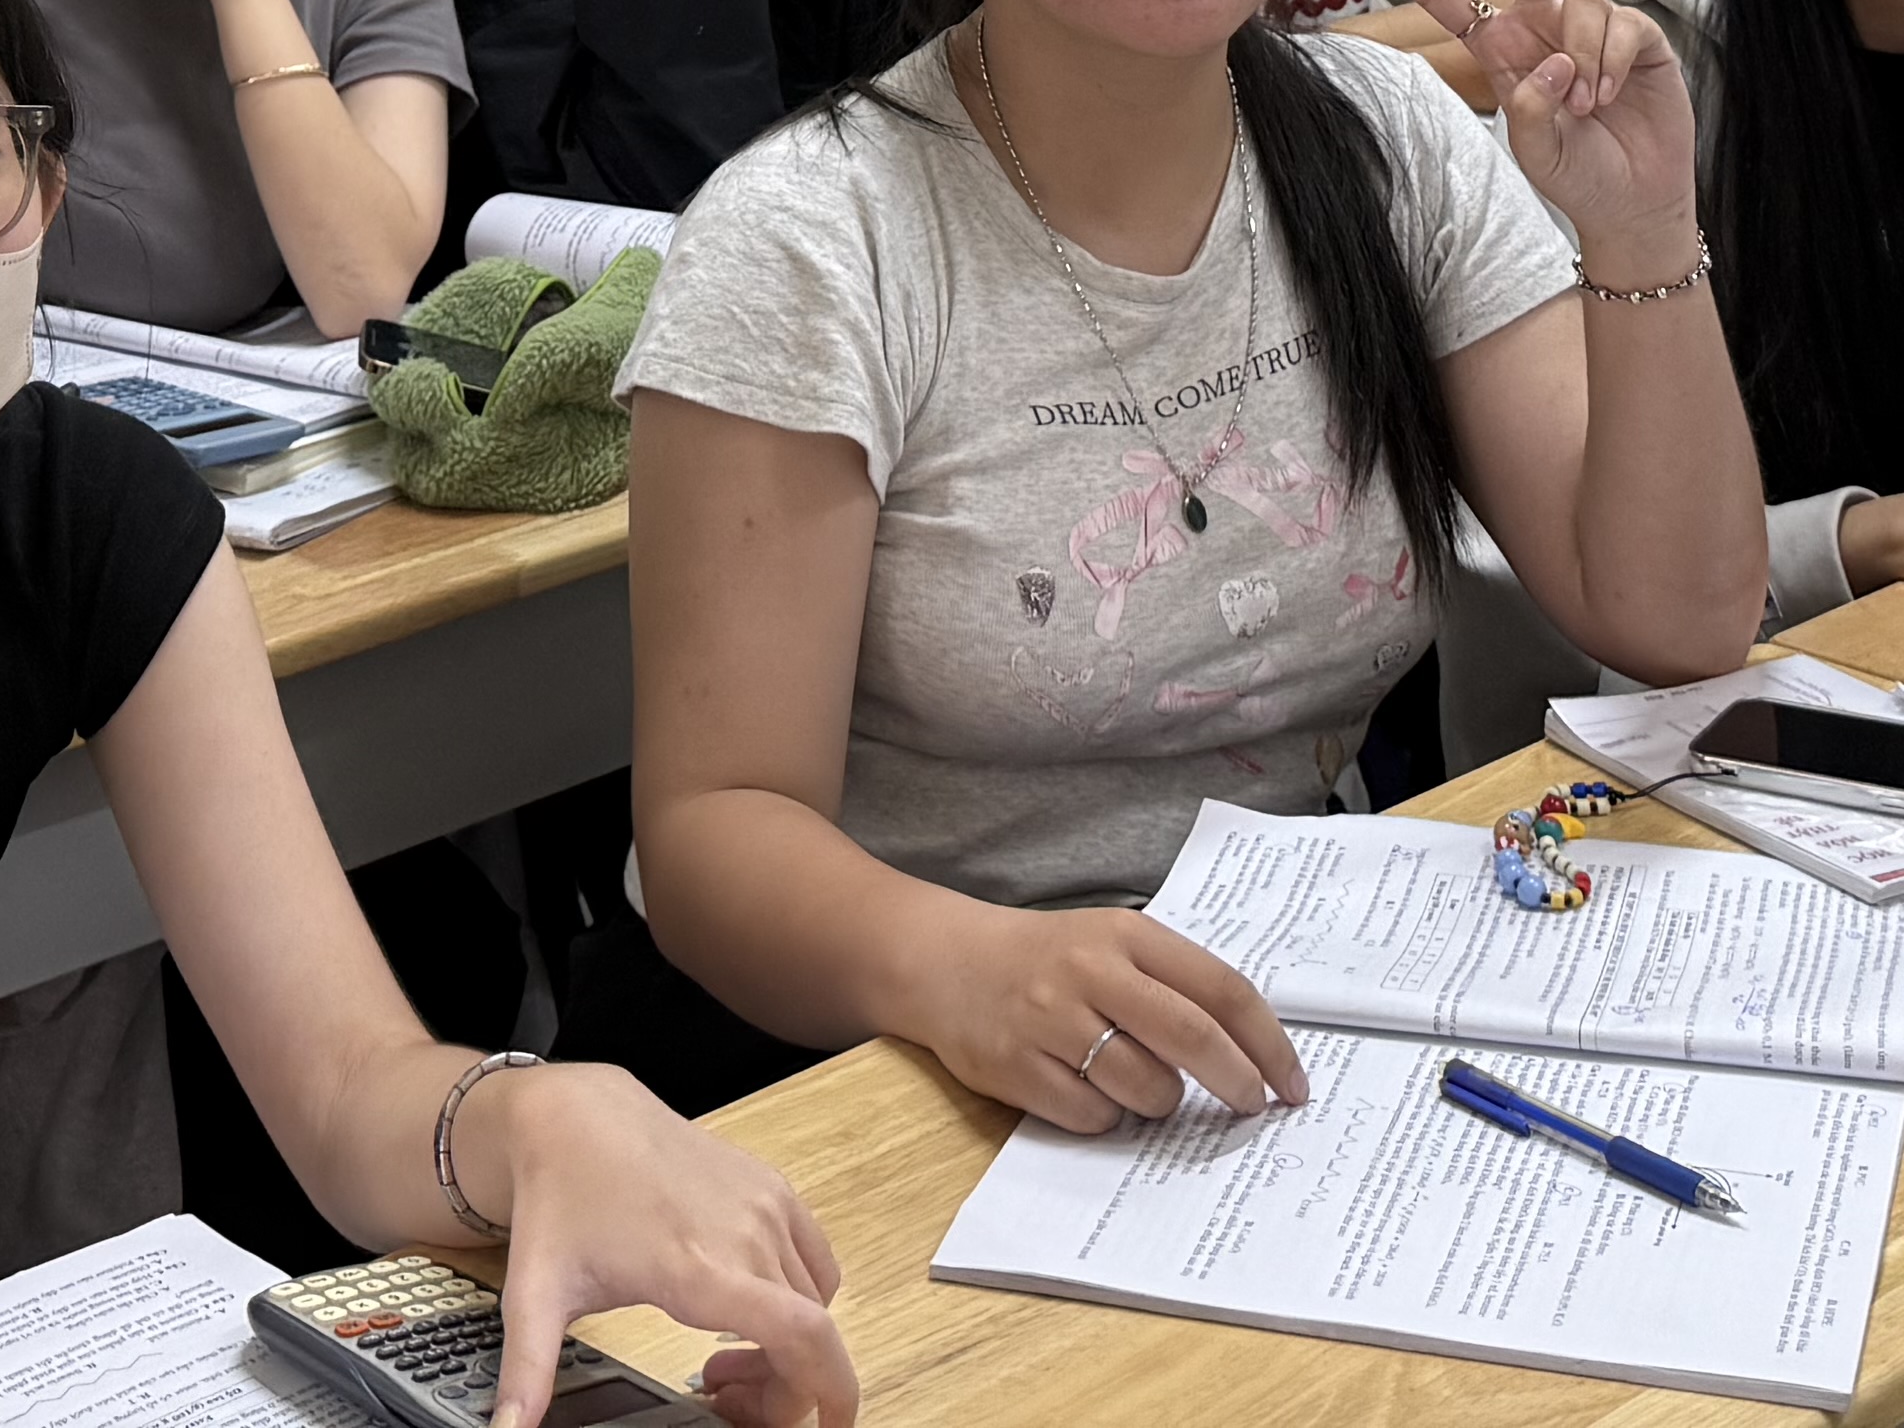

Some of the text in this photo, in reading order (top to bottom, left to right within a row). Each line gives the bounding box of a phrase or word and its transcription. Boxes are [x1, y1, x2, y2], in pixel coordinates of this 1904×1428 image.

[1029, 329, 1322, 428] DREAM COME TRUE
